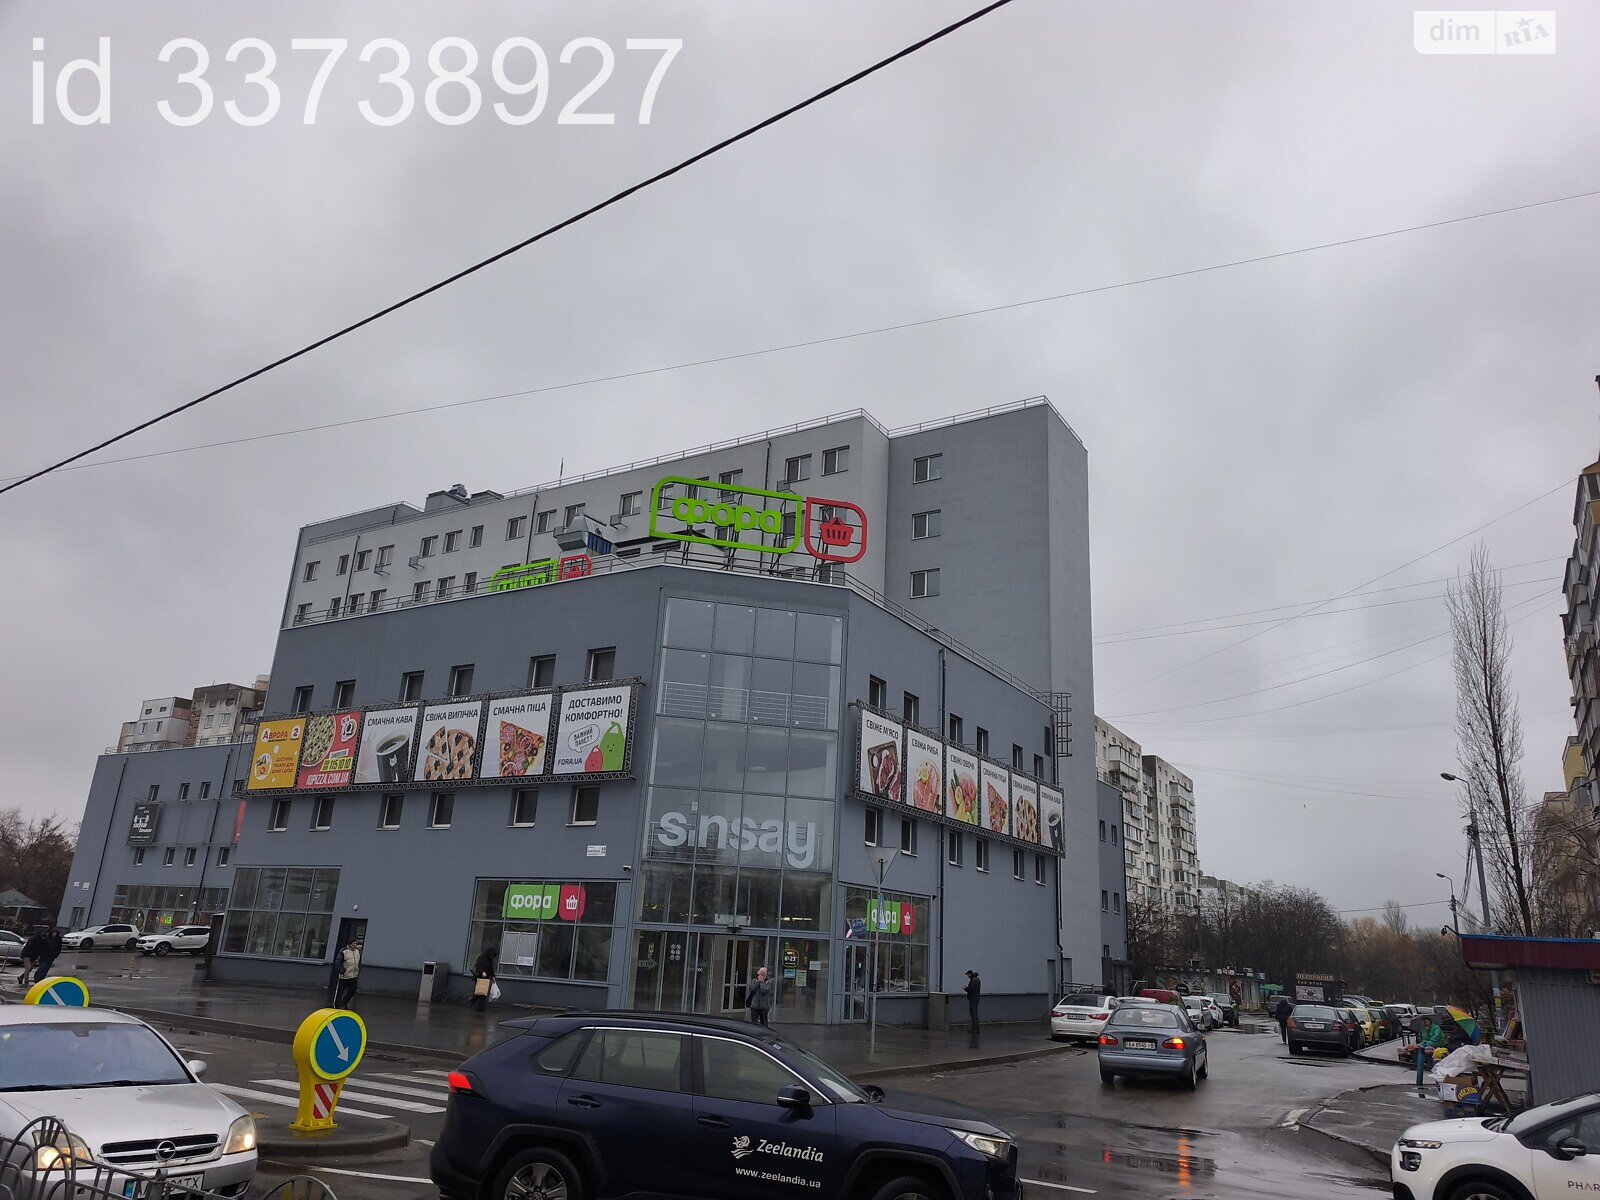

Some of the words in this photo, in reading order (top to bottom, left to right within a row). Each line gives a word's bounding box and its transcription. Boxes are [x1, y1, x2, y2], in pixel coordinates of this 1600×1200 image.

[672, 497, 782, 534] фора
[493, 704, 525, 716] СМАЧНА
[527, 702, 546, 712] ПІЦА
[568, 694, 622, 710] ДОСТАВИМО
[367, 716, 395, 727] СМАЧНА
[396, 715, 413, 724] КАВА
[425, 713, 446, 722] СВІЖА
[448, 709, 478, 719] ВИПІЧКА
[565, 708, 623, 722] КОМФОРТНО!
[293, 727, 299, 737] 2
[574, 727, 593, 740] ВАЖНИЙ
[866, 720, 883, 734] СВІЖЕ
[575, 735, 593, 747] ПАКЕТ?
[911, 738, 926, 751] СВІЖА
[926, 744, 939, 757] РИБА
[557, 758, 583, 766] FORA.UA
[658, 802, 815, 869] sinsay
[510, 894, 552, 910] фора
[757, 1139, 824, 1162] Zeelandia
[735, 1167, 821, 1188] www.zeelandia.ua
